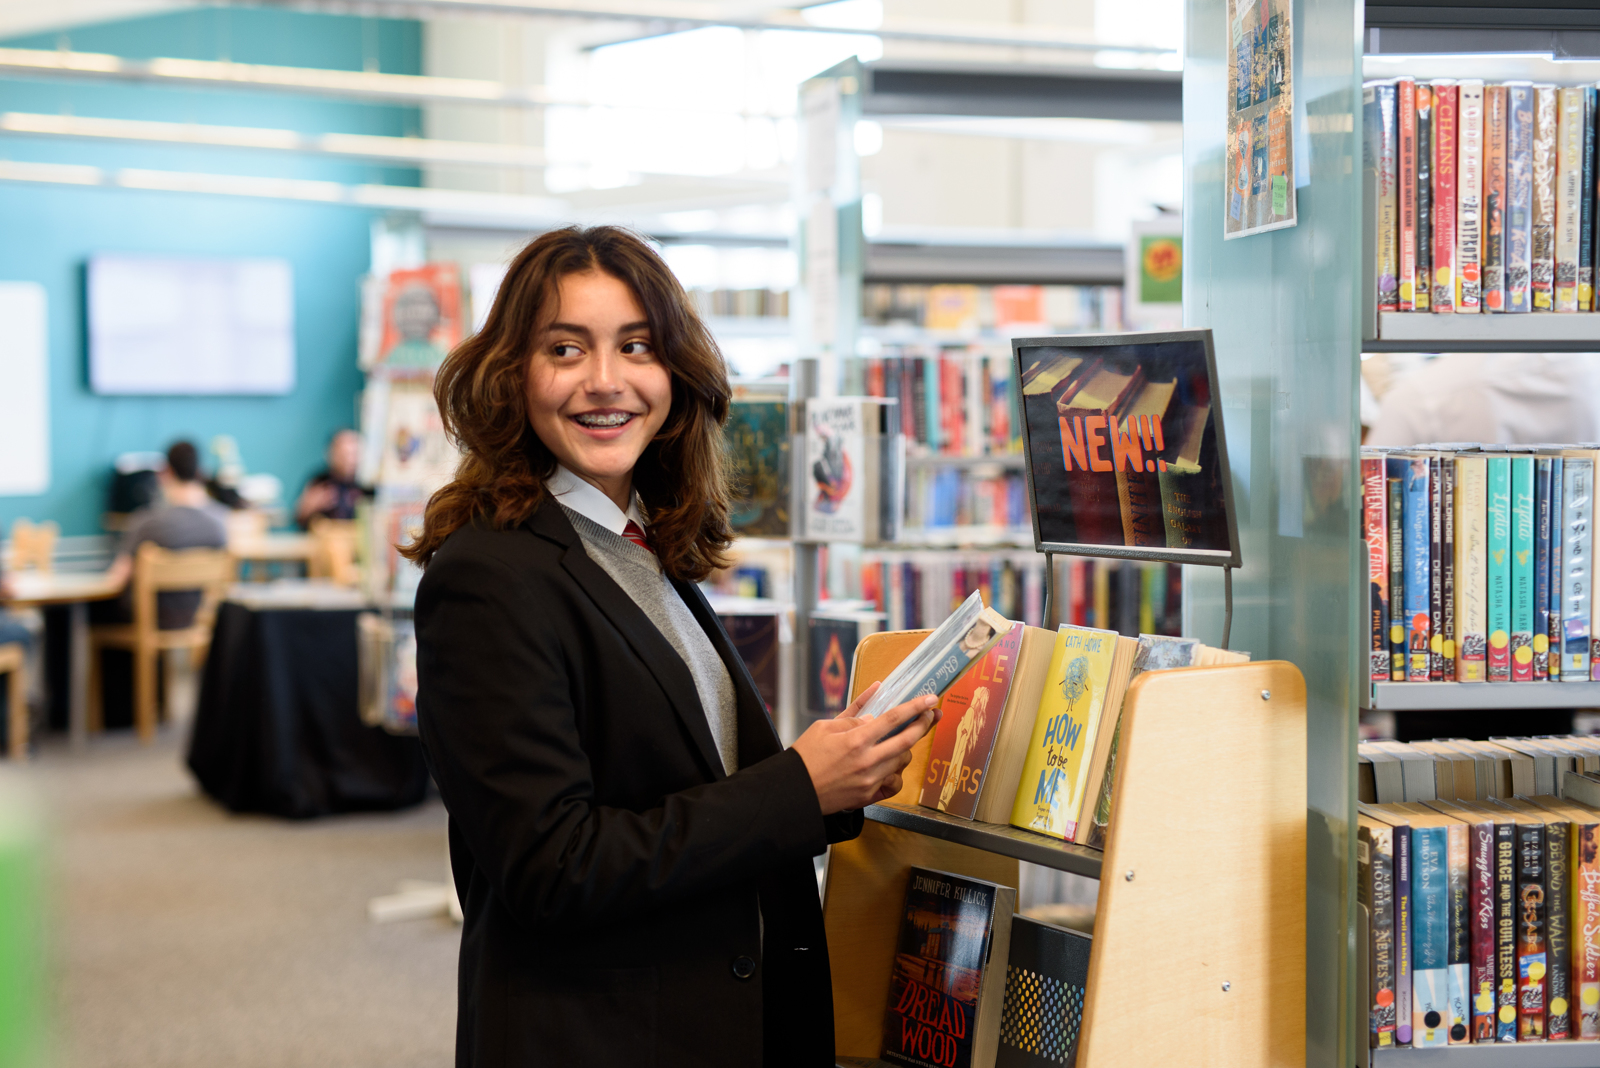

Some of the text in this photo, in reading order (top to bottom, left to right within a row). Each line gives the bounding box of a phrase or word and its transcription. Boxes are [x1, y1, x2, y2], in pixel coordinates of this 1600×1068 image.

[1403, 103, 1411, 131] STORY
[1439, 105, 1452, 175] CHAINS
[1403, 210, 1411, 228] KHAN
[1565, 228, 1574, 243] SUN
[1566, 212, 1575, 226] THE
[1581, 221, 1590, 241] Reid
[1057, 413, 1168, 473] NEW!!
[1366, 474, 1383, 510] WHEN
[1432, 472, 1440, 543] JIM ELDRIDGE
[1413, 508, 1424, 544] Rogue's
[1488, 492, 1508, 541] Lydia
[1512, 493, 1533, 542] Lydia
[1366, 523, 1383, 552] SKY
[1392, 529, 1402, 573] TRENCHES
[1552, 546, 1561, 568] WAR
[1445, 564, 1453, 588] THE
[1432, 560, 1440, 635] DESERT DAN
[1494, 575, 1503, 631] NATASHA FARR
[1518, 576, 1527, 632] NATASHA FARR
[1372, 609, 1380, 628] PHIL
[1065, 635, 1103, 653] CATH HOWE
[935, 655, 959, 681] Blue
[1042, 712, 1083, 752] HOW
[927, 758, 983, 796] STARS
[1046, 745, 1068, 770] to be
[1033, 767, 1067, 810] ME
[1421, 835, 1430, 890] IBBOTSON
[1429, 852, 1438, 873] EVA
[1499, 842, 1512, 882] GRACE
[1530, 831, 1538, 878] ELIZABETH
[912, 875, 988, 907] JENNIFER KILLICK
[1373, 860, 1383, 916] HOOPER
[1475, 831, 1493, 929] Smuggler's Kiss
[1499, 884, 1511, 900] AND
[1549, 840, 1565, 958] BEYOND THE WALL
[1501, 901, 1511, 917] THE
[1521, 884, 1543, 952] CRUSADE
[1580, 865, 1599, 979] Buffalo Soldier
[1372, 929, 1390, 979] NEWES
[1499, 918, 1513, 978] GUILTLESS
[1399, 961, 1407, 976] Boy
[893, 979, 966, 1040] DREAD
[901, 1017, 958, 1068] WOOD
